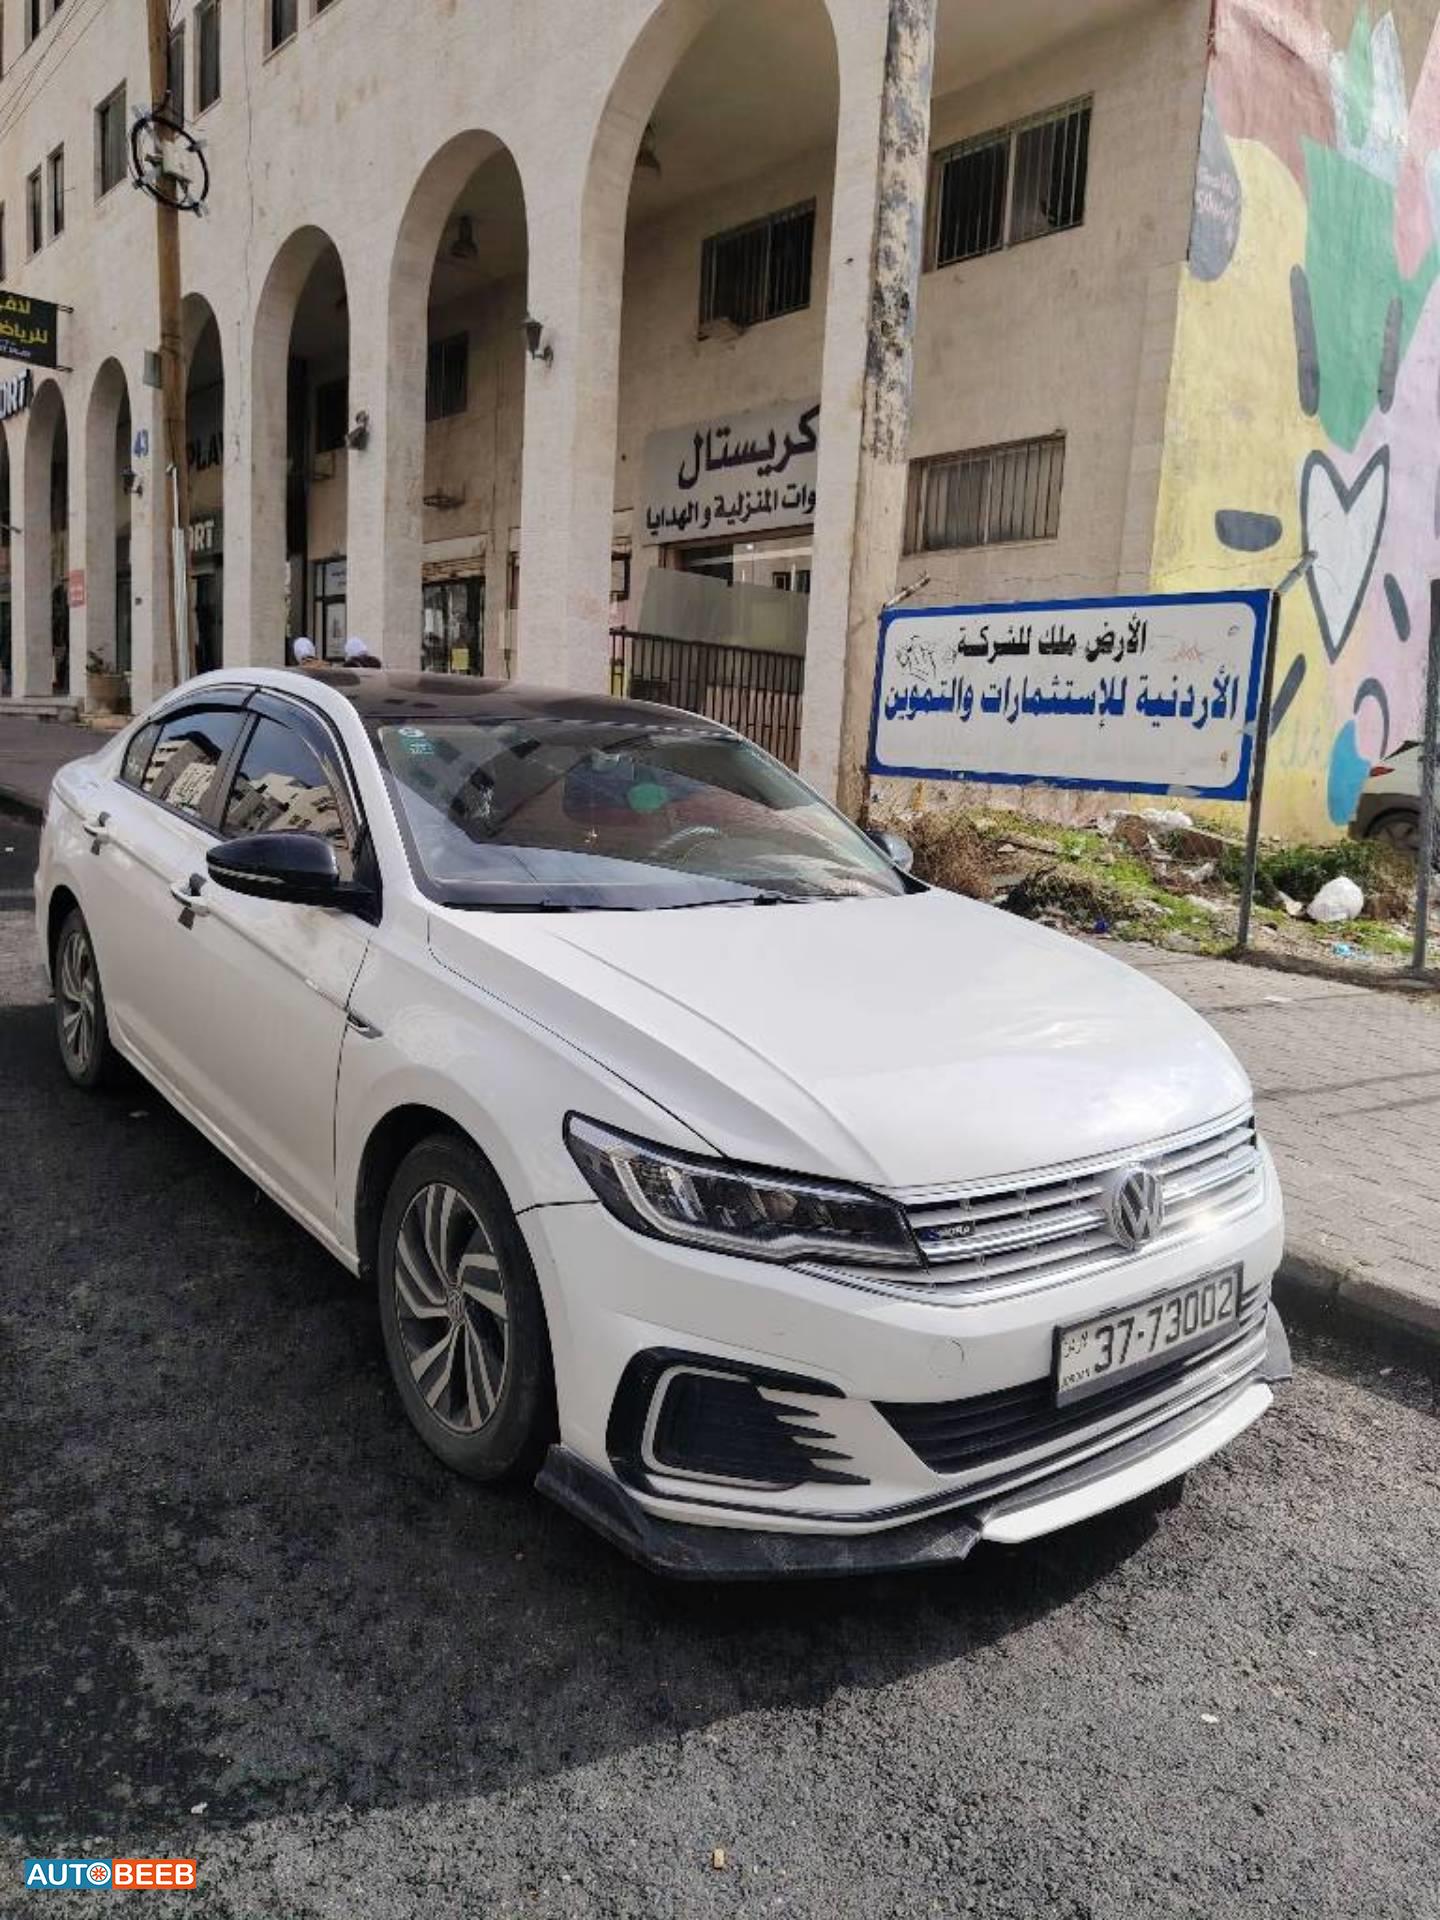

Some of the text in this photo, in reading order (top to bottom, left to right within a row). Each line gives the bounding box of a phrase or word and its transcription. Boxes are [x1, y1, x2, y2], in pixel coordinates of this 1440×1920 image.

[678, 404, 821, 490] كريستال
[714, 488, 778, 525] المنزلية
[957, 625, 1032, 664] للشركة
[1038, 624, 1077, 656] ملك
[1086, 612, 1147, 663] الأرض
[884, 675, 974, 723] والتموين
[1136, 665, 1239, 729] الأردنية
[1094, 1276, 1235, 1372] 37-73002
